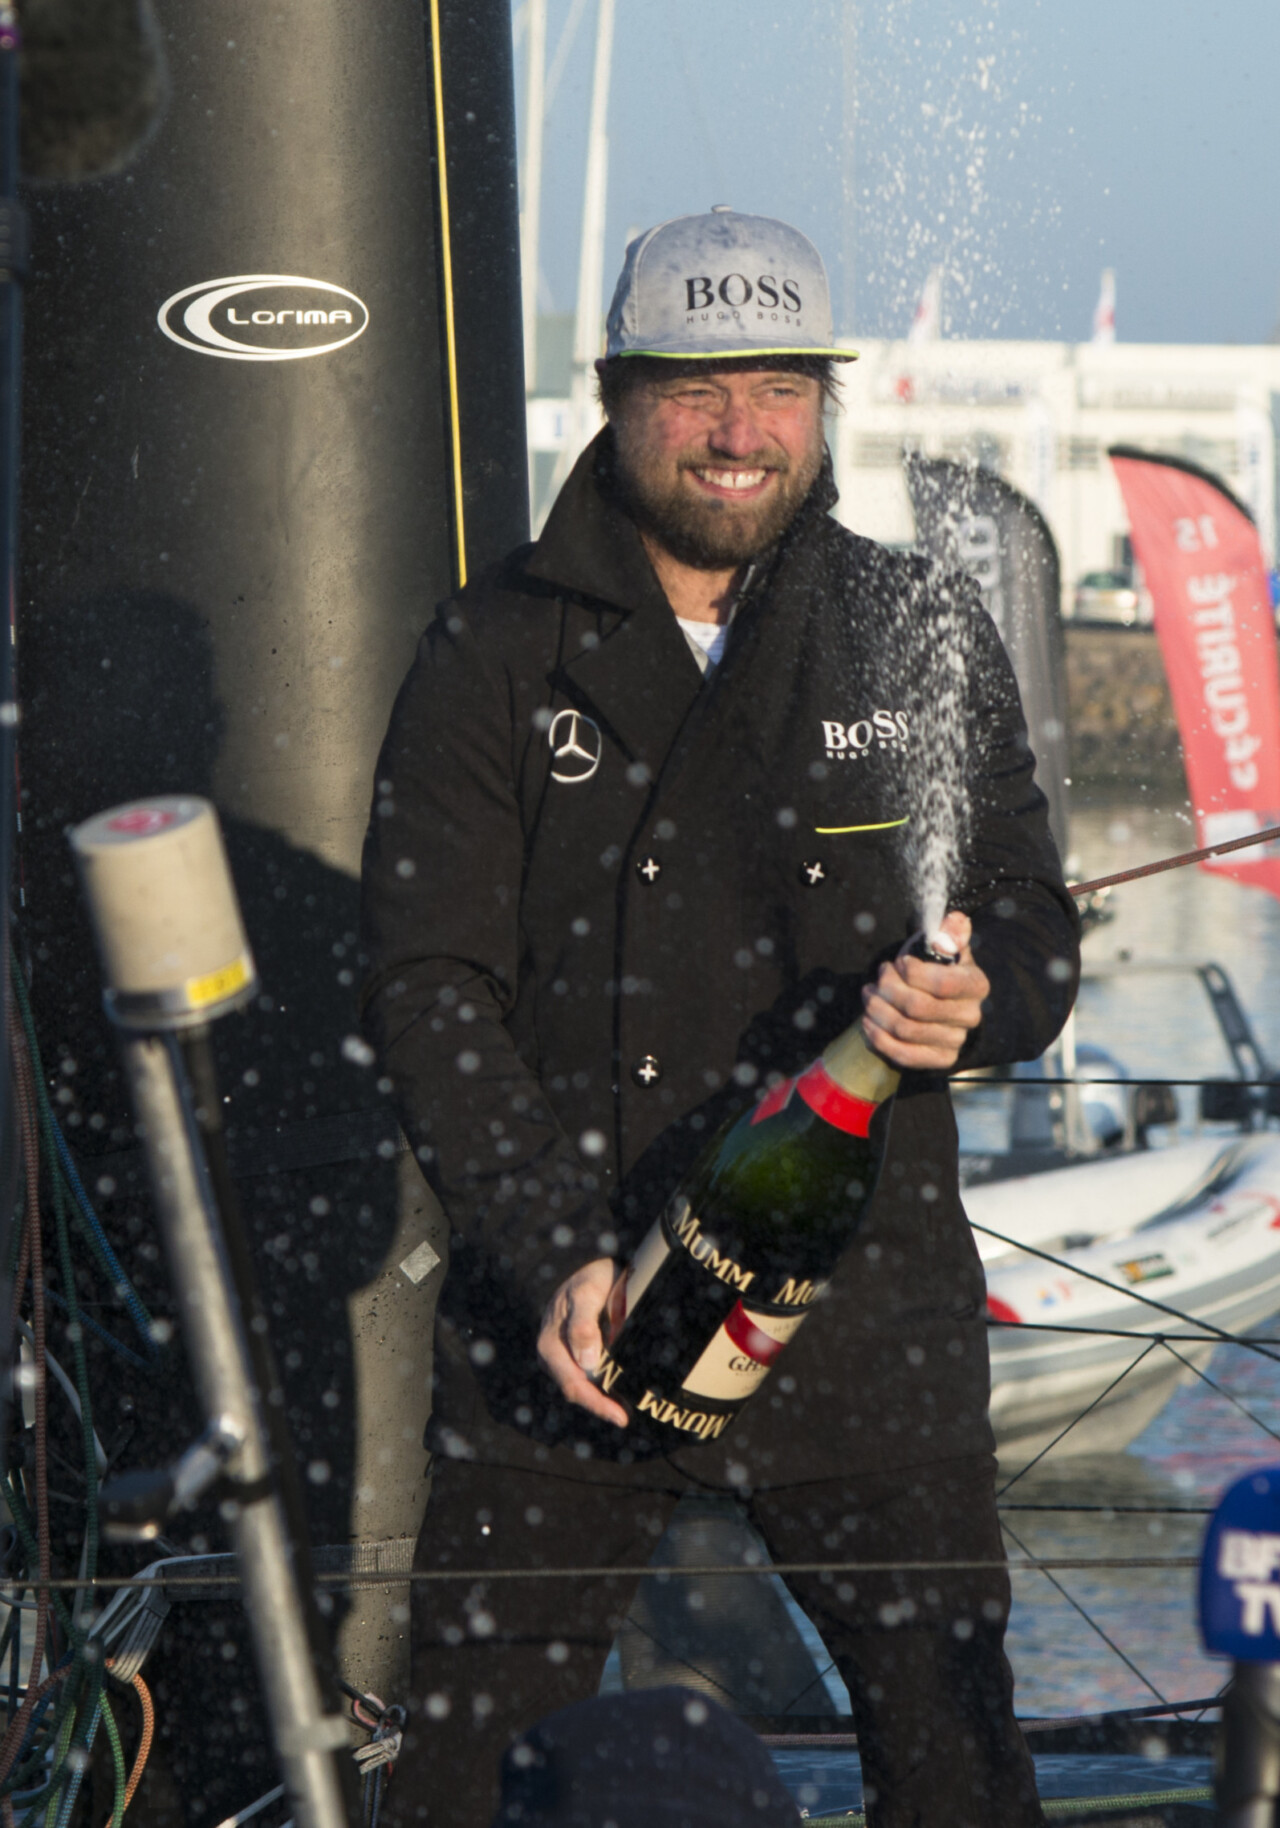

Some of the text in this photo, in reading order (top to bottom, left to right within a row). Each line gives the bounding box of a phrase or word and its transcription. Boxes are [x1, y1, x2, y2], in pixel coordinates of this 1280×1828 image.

[685, 273, 801, 313] BOSS
[687, 311, 801, 327] HUGO BOSS
[821, 710, 909, 749] BOSS
[672, 1203, 755, 1292] MUMM
[636, 1390, 733, 1440] MUMM
